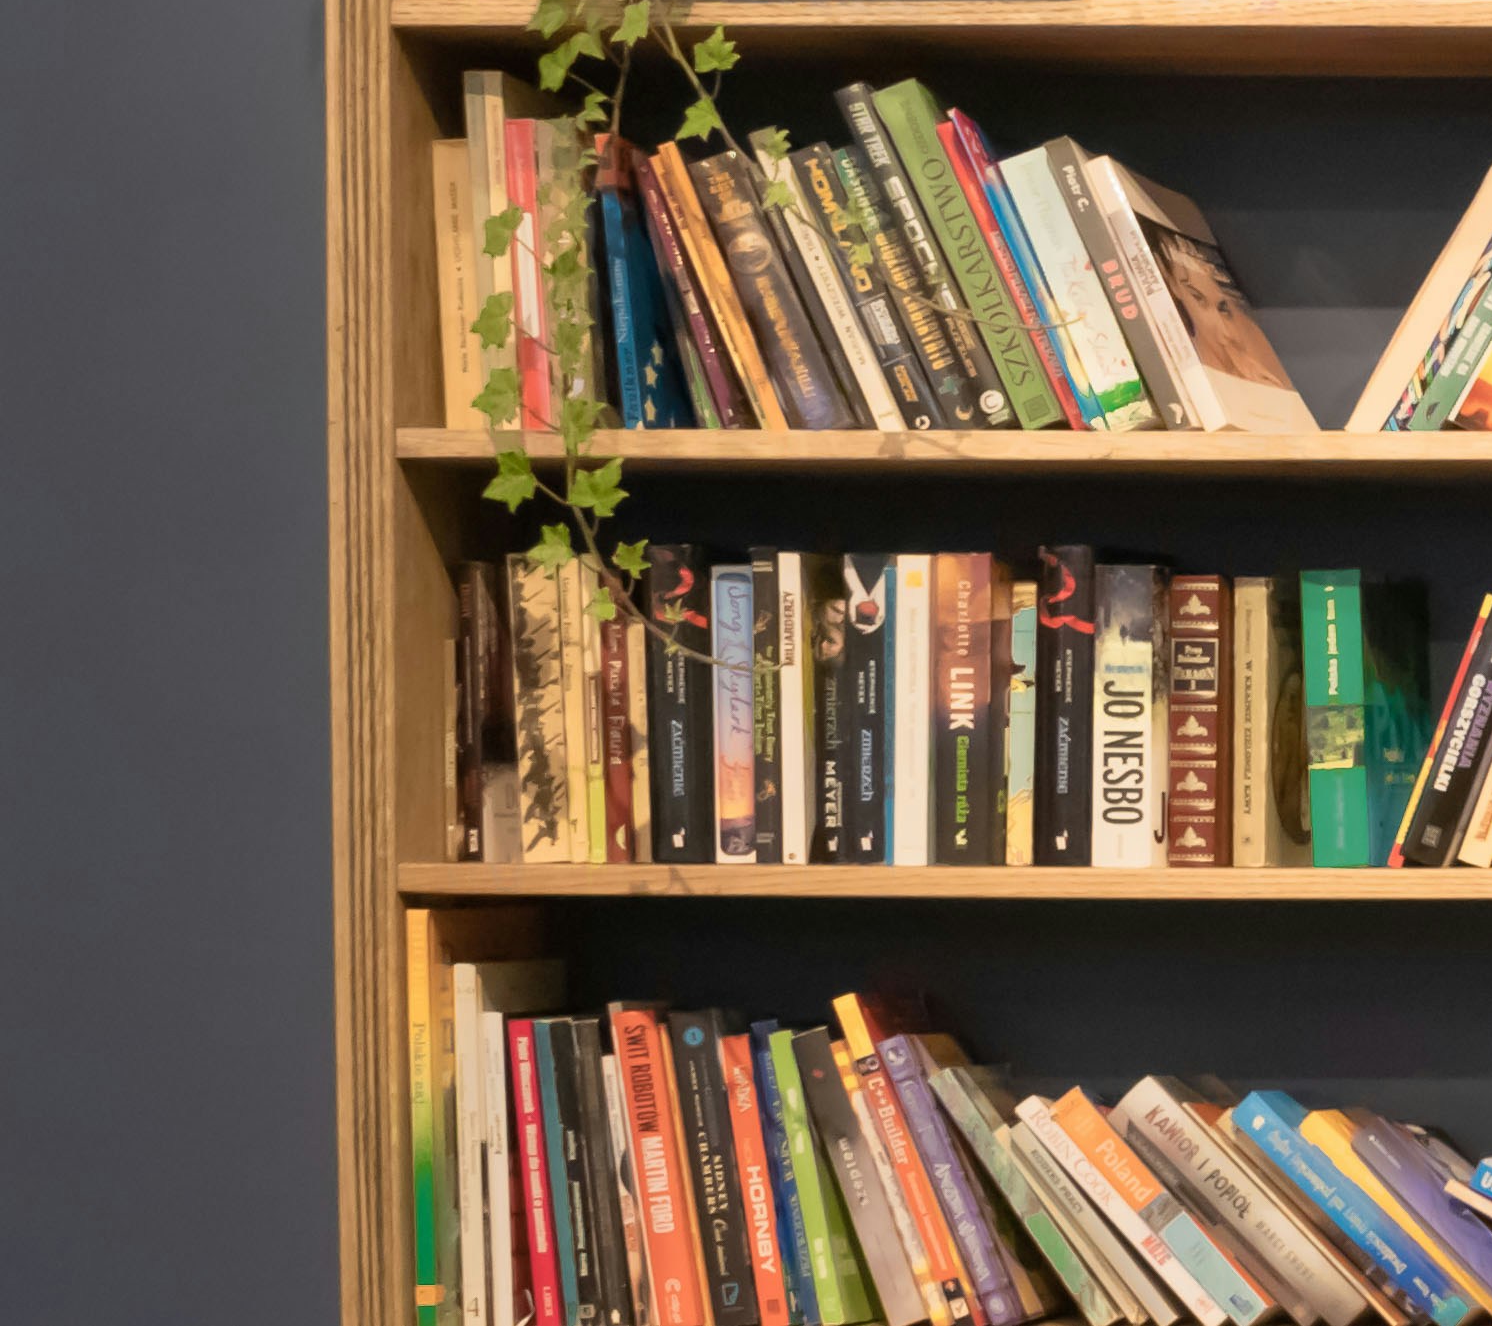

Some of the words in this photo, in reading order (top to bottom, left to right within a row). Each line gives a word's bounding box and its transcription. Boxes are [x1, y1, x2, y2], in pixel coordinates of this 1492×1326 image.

[845, 99, 877, 138] STAR
[861, 132, 892, 171] TREK
[1060, 162, 1085, 198] Piotr
[1074, 194, 1092, 213] C.
[1099, 255, 1140, 324] BRUD
[780, 590, 796, 666] MILIARDERZY
[954, 579, 972, 656] Charlotte
[948, 666, 976, 730] LINK
[1100, 679, 1145, 721] JO
[1428, 670, 1491, 794] GORSZYCIELKI
[822, 758, 838, 828] MEYER
[1098, 728, 1146, 826] NESBO
[1241, 783, 1252, 815] KAWY
[621, 1022, 655, 1062] ŚWIT
[626, 1061, 663, 1135] ROBOTÓW
[866, 1075, 913, 1167] C++Builder
[638, 1133, 670, 1194] MARTIN
[695, 1130, 718, 1215] CHAMBERS
[1027, 1104, 1080, 1164] ROBIN
[1069, 1153, 1118, 1208] COOK
[1092, 1133, 1155, 1209] Poland
[1142, 1098, 1206, 1165] KAWIOR
[1203, 1164, 1257, 1222] POPIÓŁ
[647, 1192, 676, 1236] FORD
[743, 1164, 777, 1275] HORNBY
[1055, 1182, 1086, 1217] PRACY
